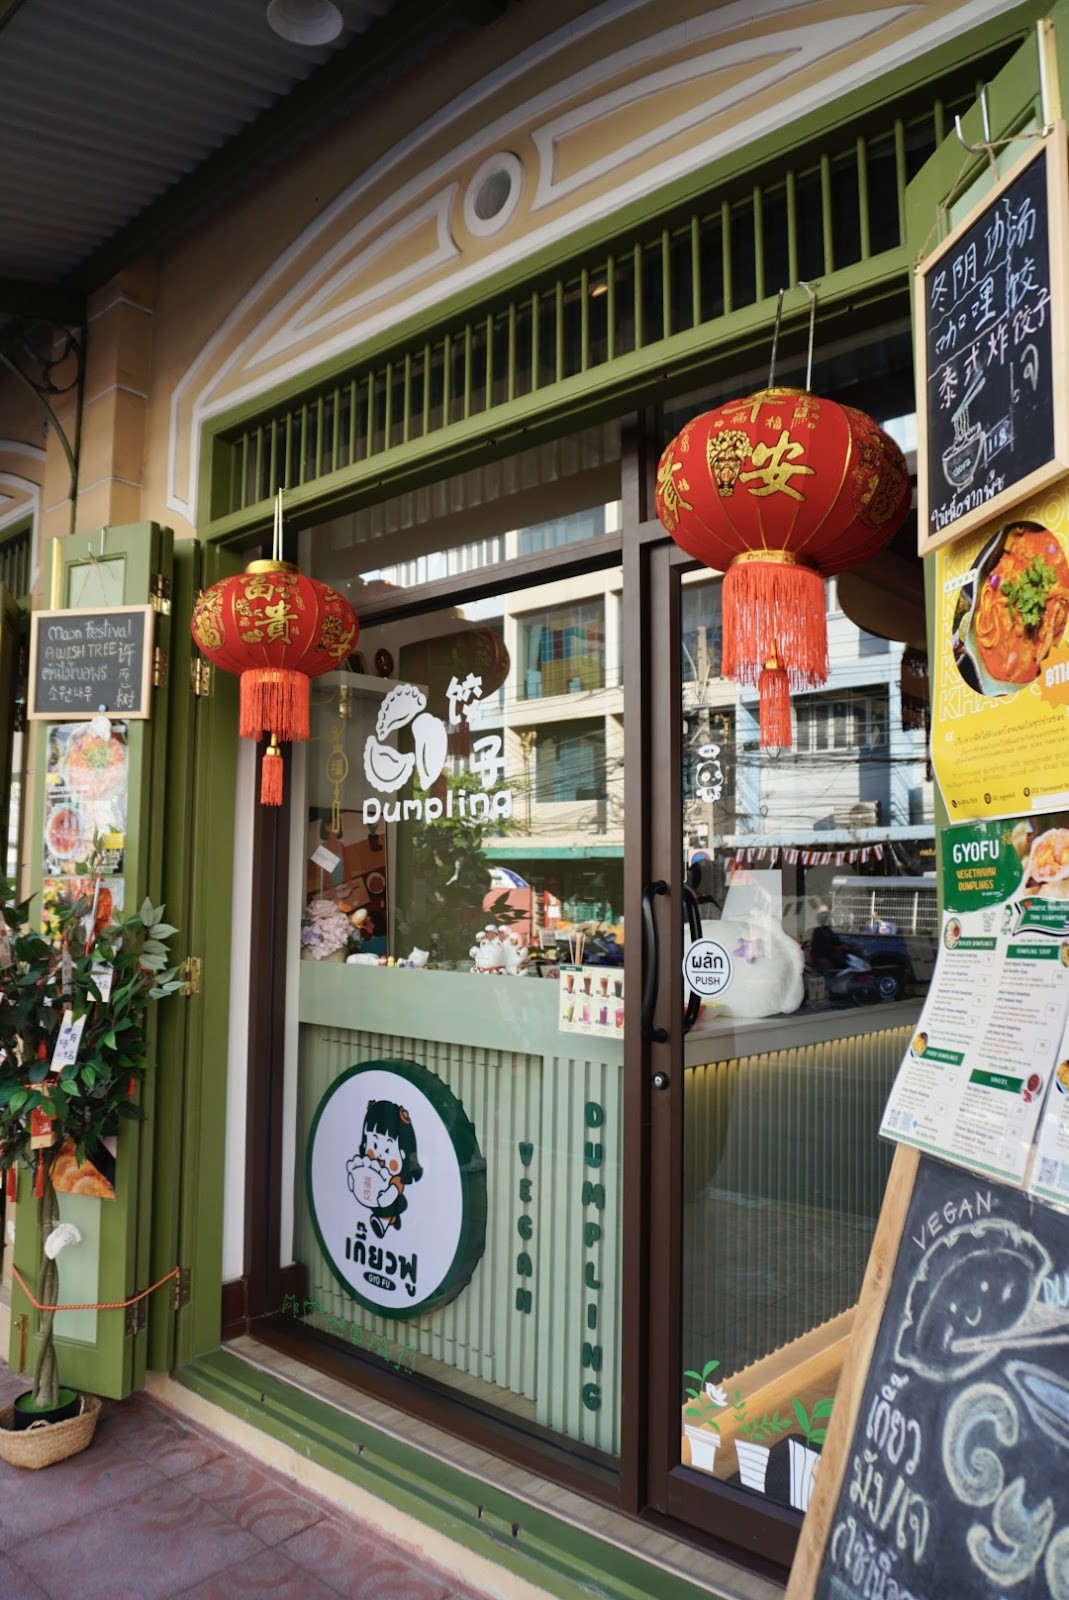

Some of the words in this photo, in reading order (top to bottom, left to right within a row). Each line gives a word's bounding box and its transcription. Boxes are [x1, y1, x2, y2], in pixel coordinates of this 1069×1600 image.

[87, 641, 117, 658] TREE
[952, 838, 1000, 864] GYOFU
[958, 879, 994, 891] DUMPLINGS
[692, 952, 723, 970] ผลัก
[695, 975, 721, 986] PUSH
[912, 1190, 992, 1251] VEGAN
[345, 1221, 418, 1298] เกี๊ยวฟู
[368, 1273, 380, 1285] GYO
[381, 1279, 391, 1289] FU
